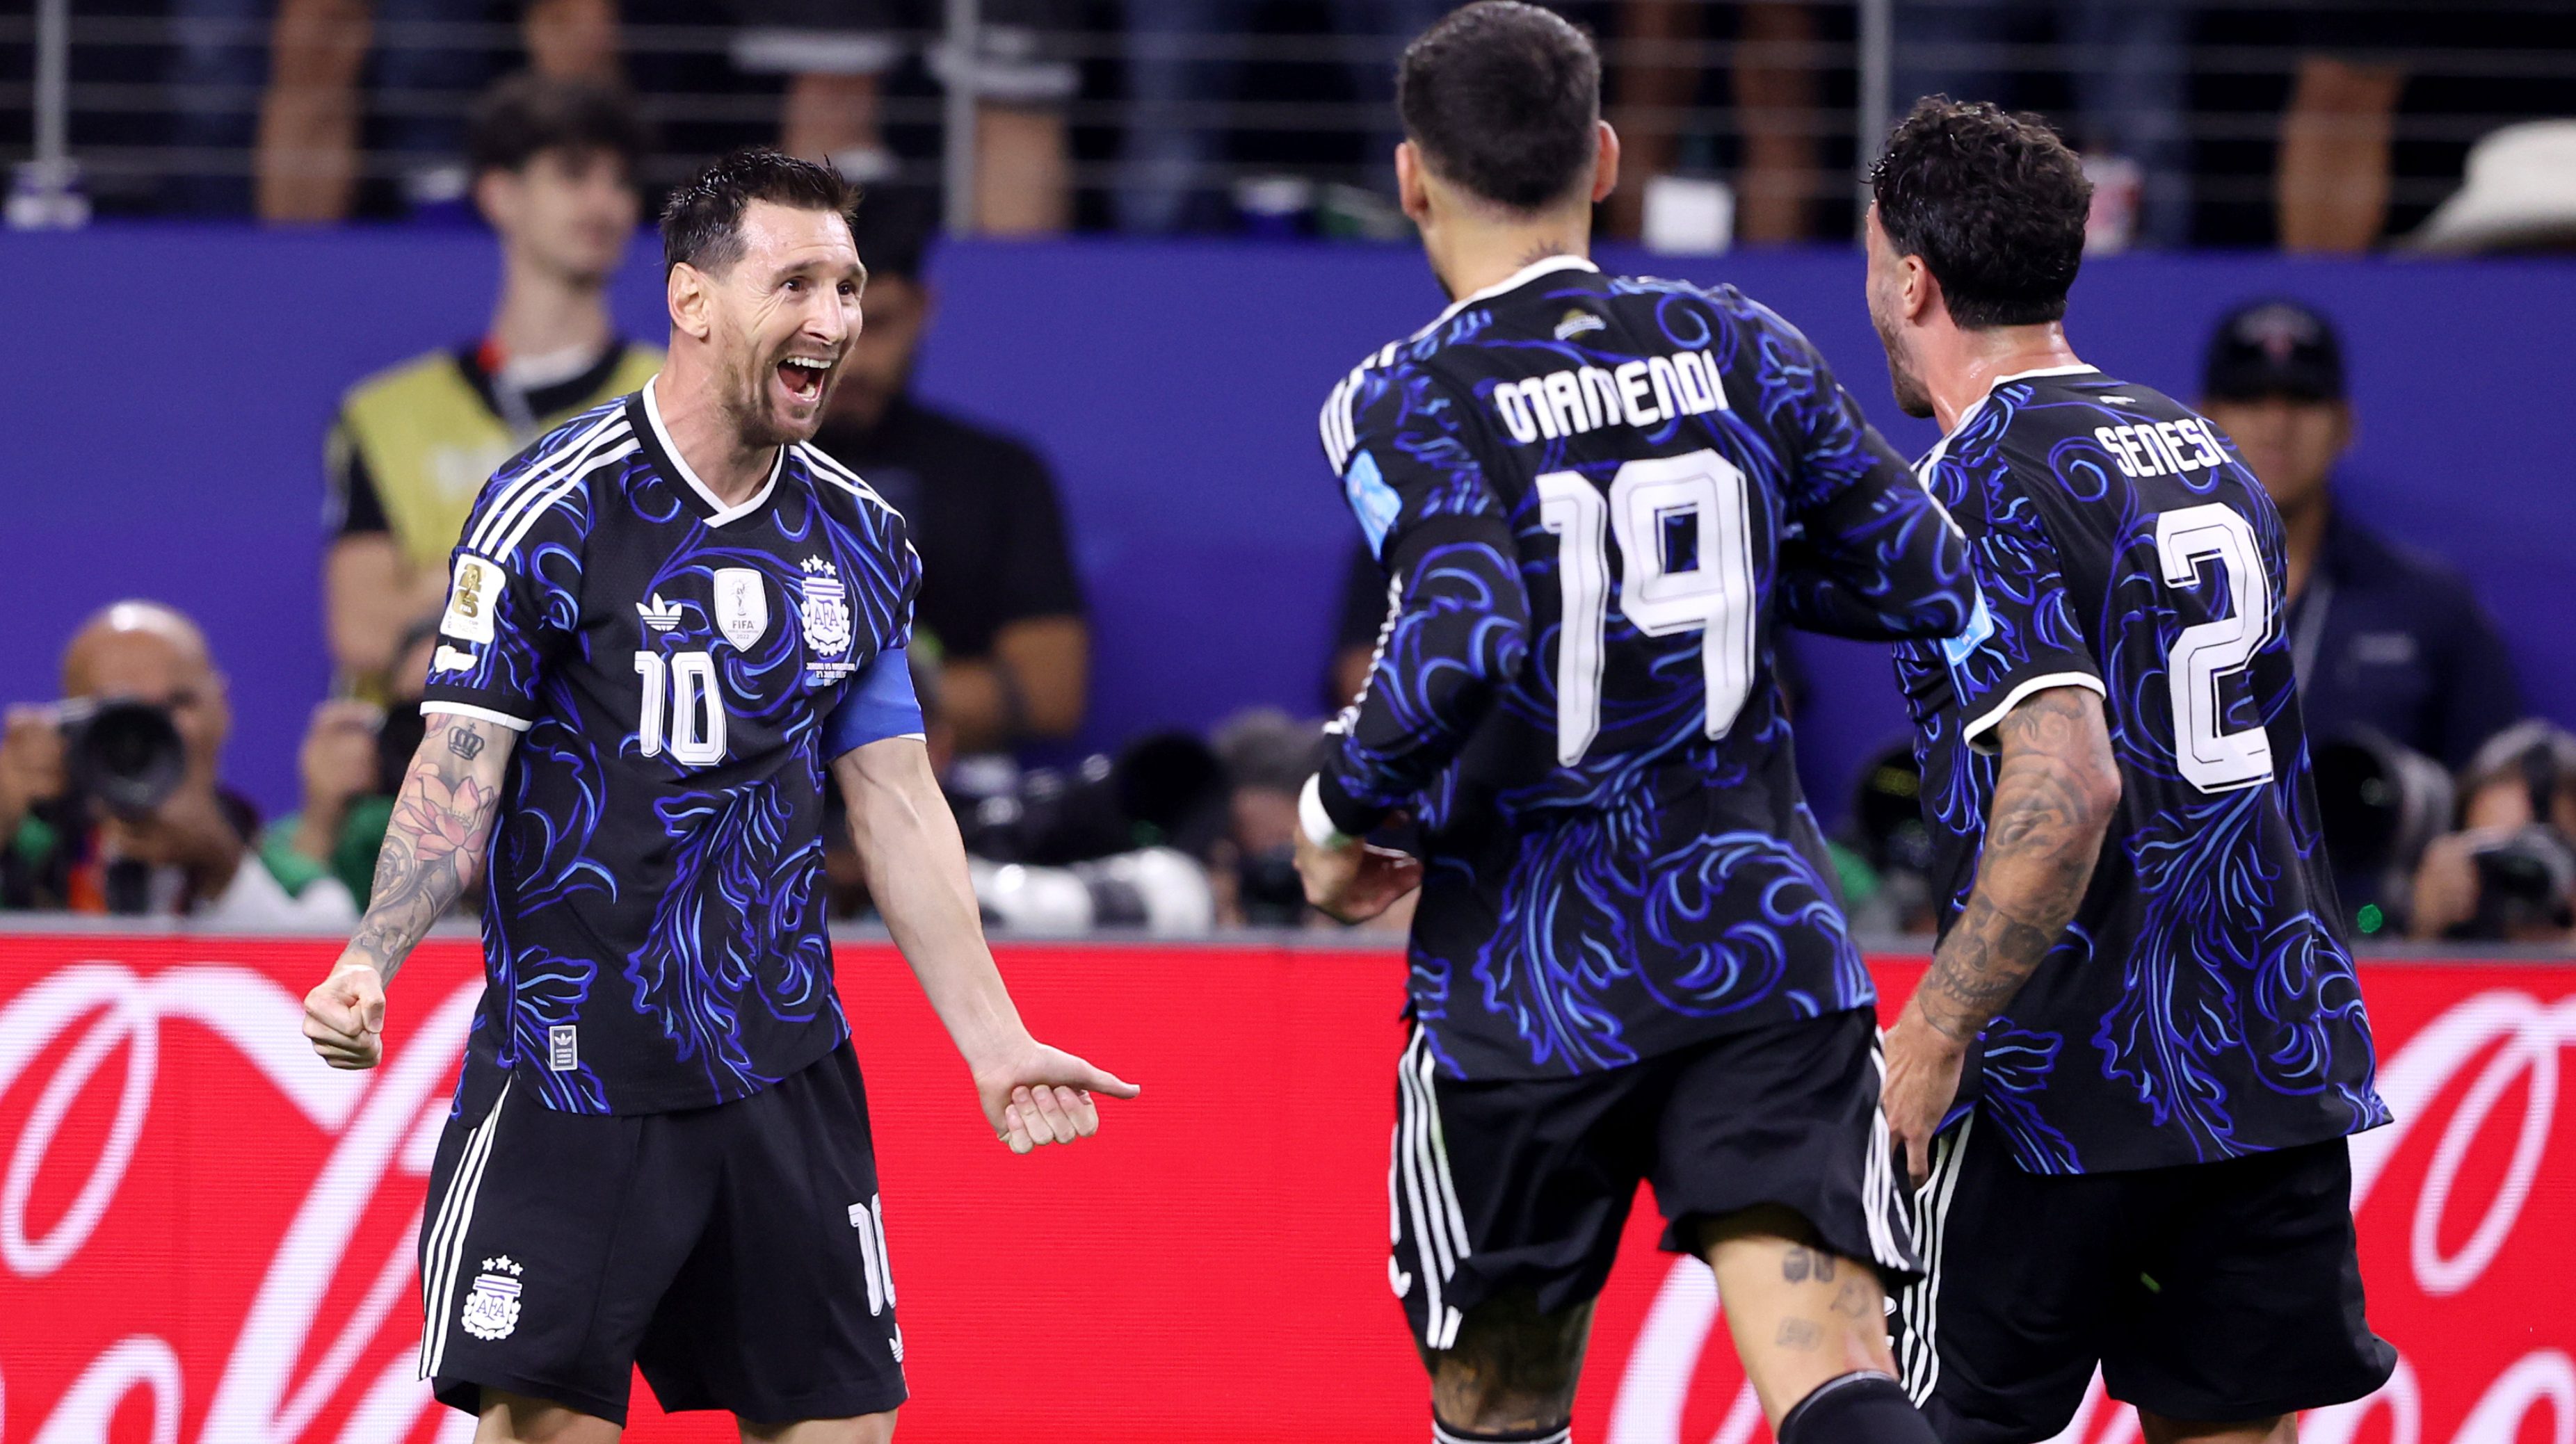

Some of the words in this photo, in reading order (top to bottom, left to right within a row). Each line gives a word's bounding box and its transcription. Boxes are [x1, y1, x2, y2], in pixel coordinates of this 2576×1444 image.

[1494, 350, 1729, 444] OTAMENDI
[2094, 417, 2233, 478] SENESI
[732, 619, 755, 629] FIFA
[814, 597, 840, 633] AFA
[1534, 448, 1756, 768] 19
[2156, 501, 2274, 794] 2
[634, 650, 727, 765] 10
[475, 1292, 506, 1322] AFA
